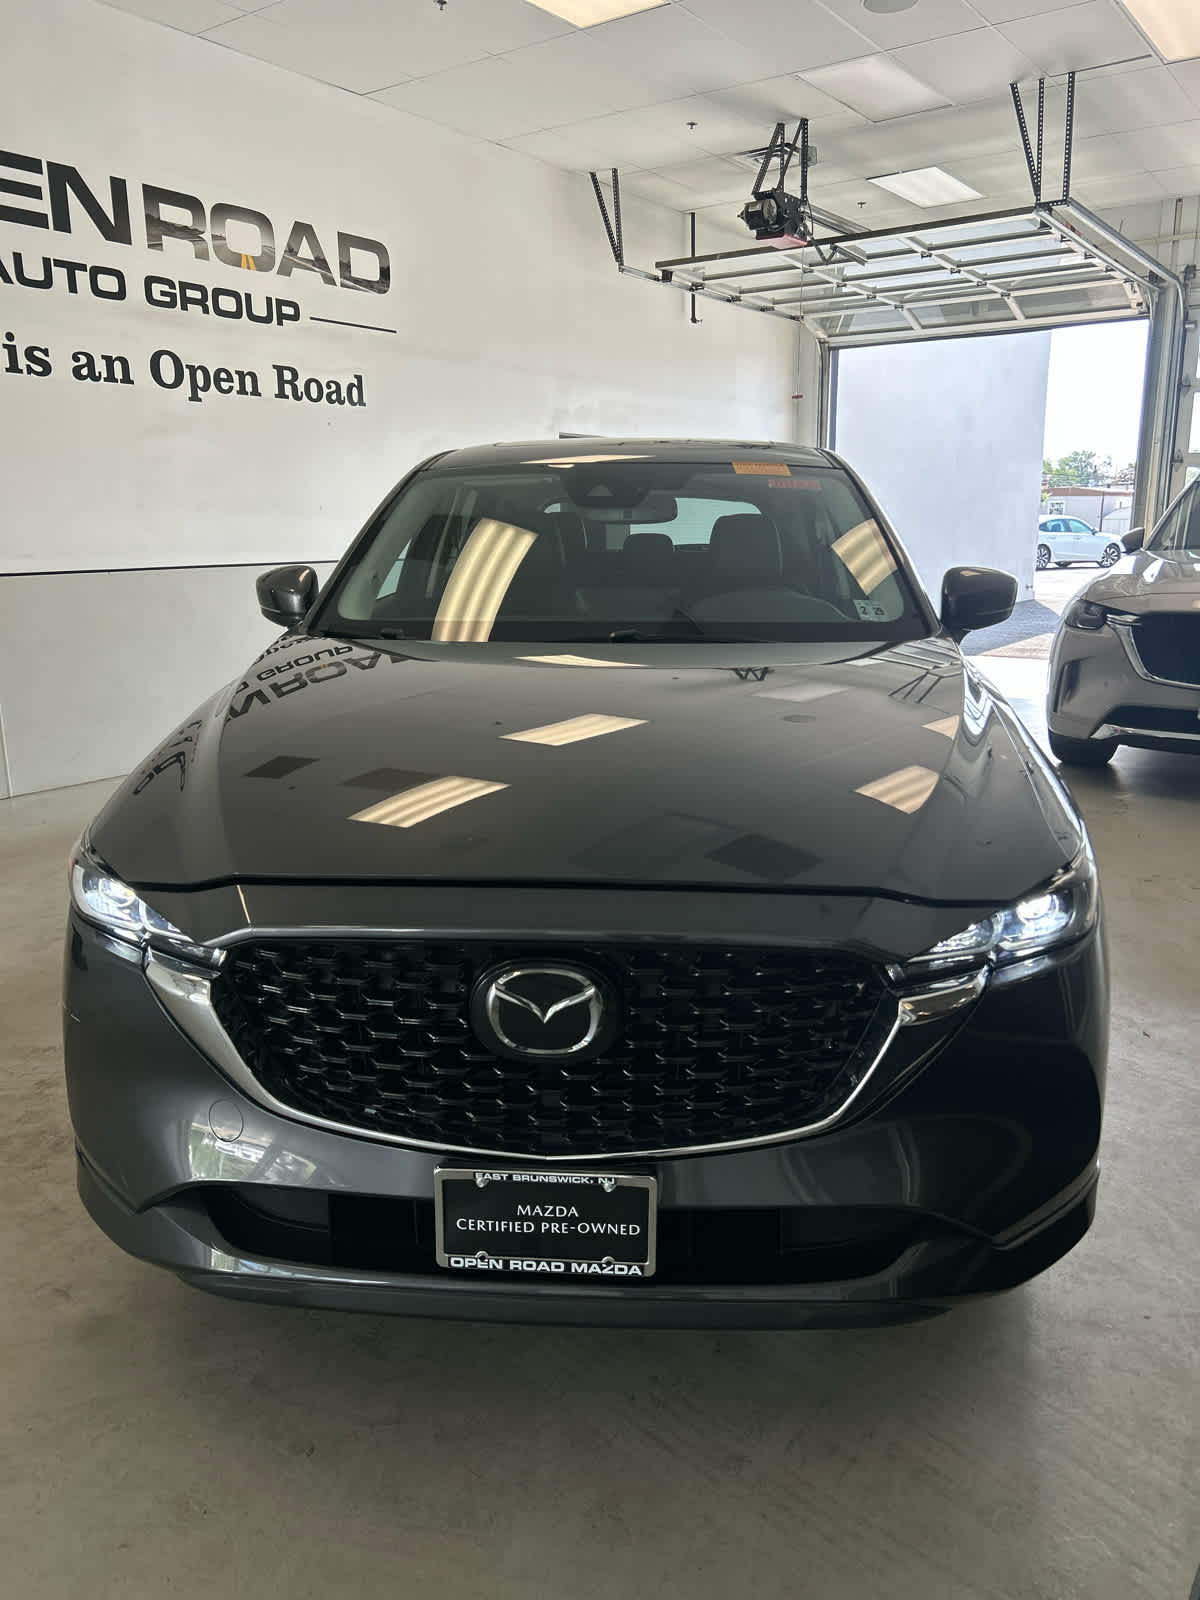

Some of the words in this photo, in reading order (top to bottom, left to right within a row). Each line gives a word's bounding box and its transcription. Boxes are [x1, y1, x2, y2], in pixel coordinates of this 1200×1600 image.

[144, 275, 300, 326] GROUP
[2, 331, 52, 377] is
[71, 350, 135, 385] an
[149, 350, 262, 403] Open
[272, 364, 367, 408] Road
[475, 1172, 508, 1181] EAST
[513, 1174, 594, 1184] BRUNSWICK,
[598, 1177, 615, 1185] NJ
[517, 1204, 579, 1218] MAZDA
[456, 1218, 535, 1234] CERTIFIED
[541, 1222, 641, 1236] PRE-OWNED
[450, 1257, 503, 1270] OPEN
[509, 1259, 565, 1272] ROAD
[571, 1262, 642, 1276] MAZDA
